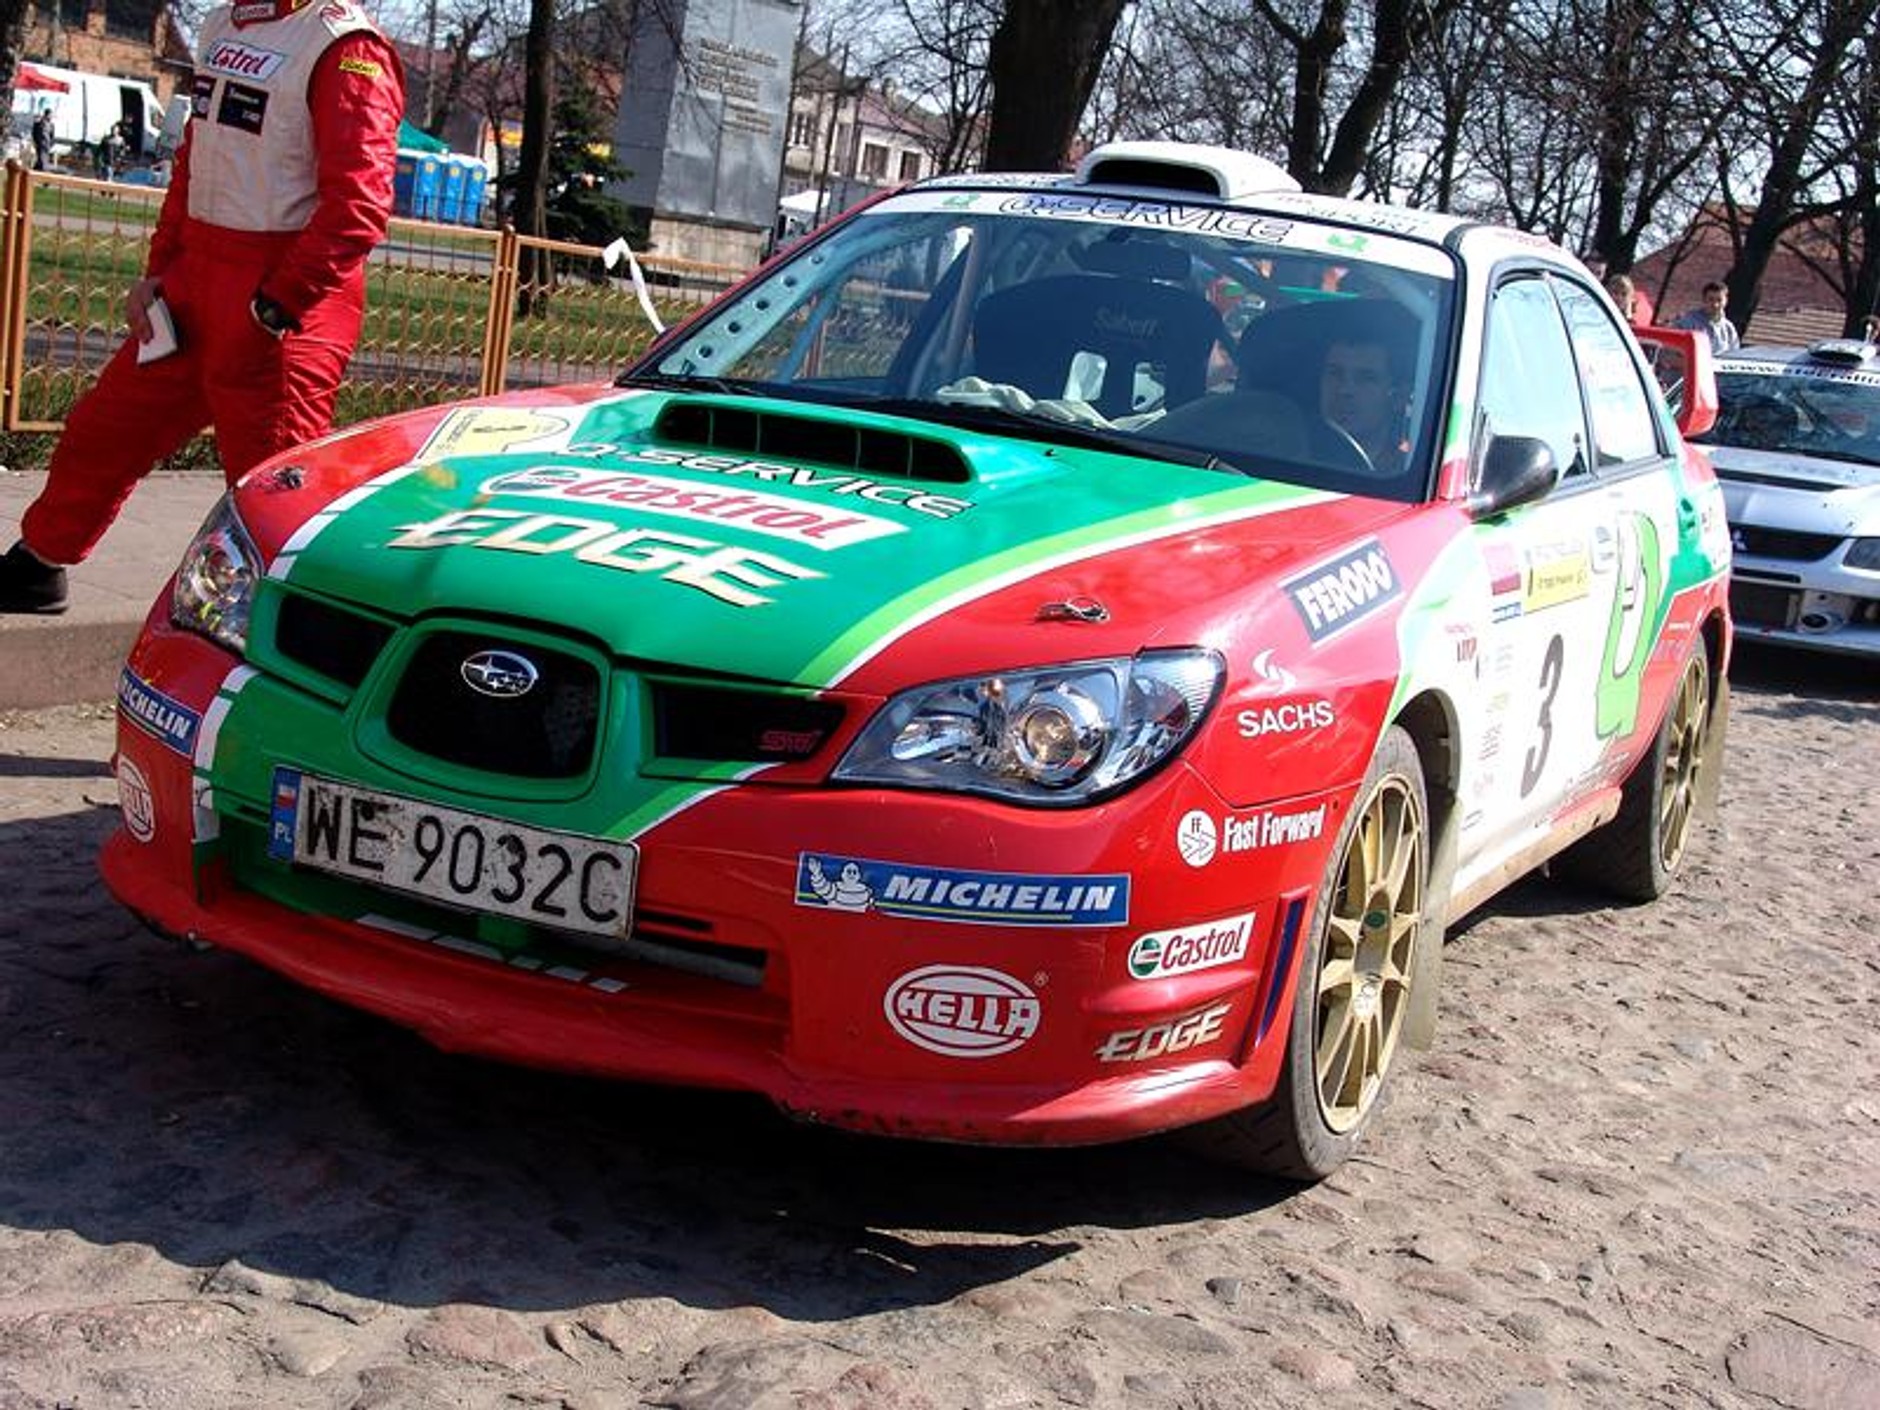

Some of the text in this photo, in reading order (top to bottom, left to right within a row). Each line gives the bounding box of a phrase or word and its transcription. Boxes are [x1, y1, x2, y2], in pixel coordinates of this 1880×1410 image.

[562, 476, 867, 539] Castrol
[386, 508, 830, 608] EDGE
[1294, 550, 1393, 632] FERODO
[1237, 701, 1334, 737] SACHS
[1520, 633, 1565, 799] 3
[274, 822, 292, 843] PL
[307, 786, 622, 923] WE 9032C
[1222, 802, 1326, 853] Fast Forward
[884, 874, 1116, 911] MICHELIN
[1161, 921, 1246, 970] Castrol
[897, 990, 1041, 1040] HELLA
[1095, 1002, 1233, 1061] EDGE
